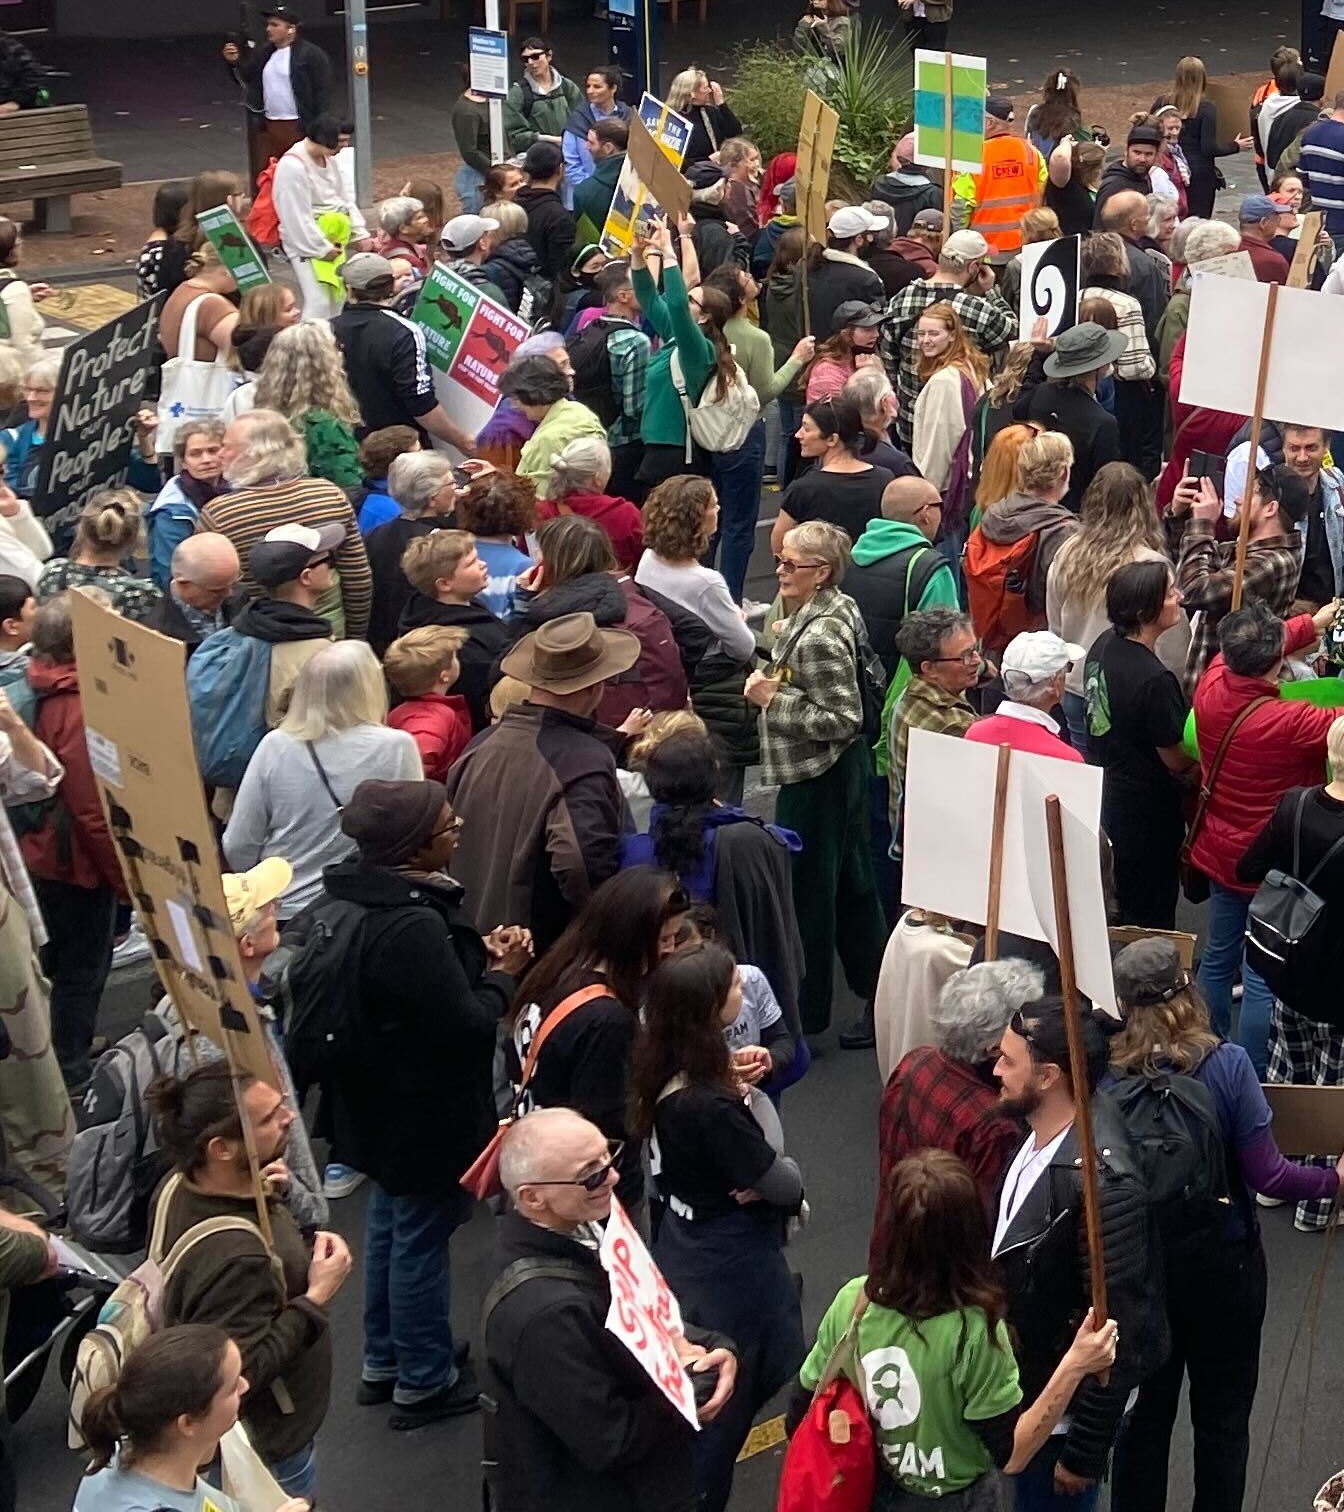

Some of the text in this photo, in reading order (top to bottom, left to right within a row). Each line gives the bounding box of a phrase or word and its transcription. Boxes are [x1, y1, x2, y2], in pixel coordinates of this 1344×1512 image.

[431, 269, 477, 308] FIGHT FOR
[479, 303, 524, 342] FIGHT FOR
[65, 302, 158, 395] Protect
[463, 354, 499, 386] NATURE
[54, 367, 145, 441] Nature
[80, 415, 108, 440] our
[48, 416, 136, 494] Peoples
